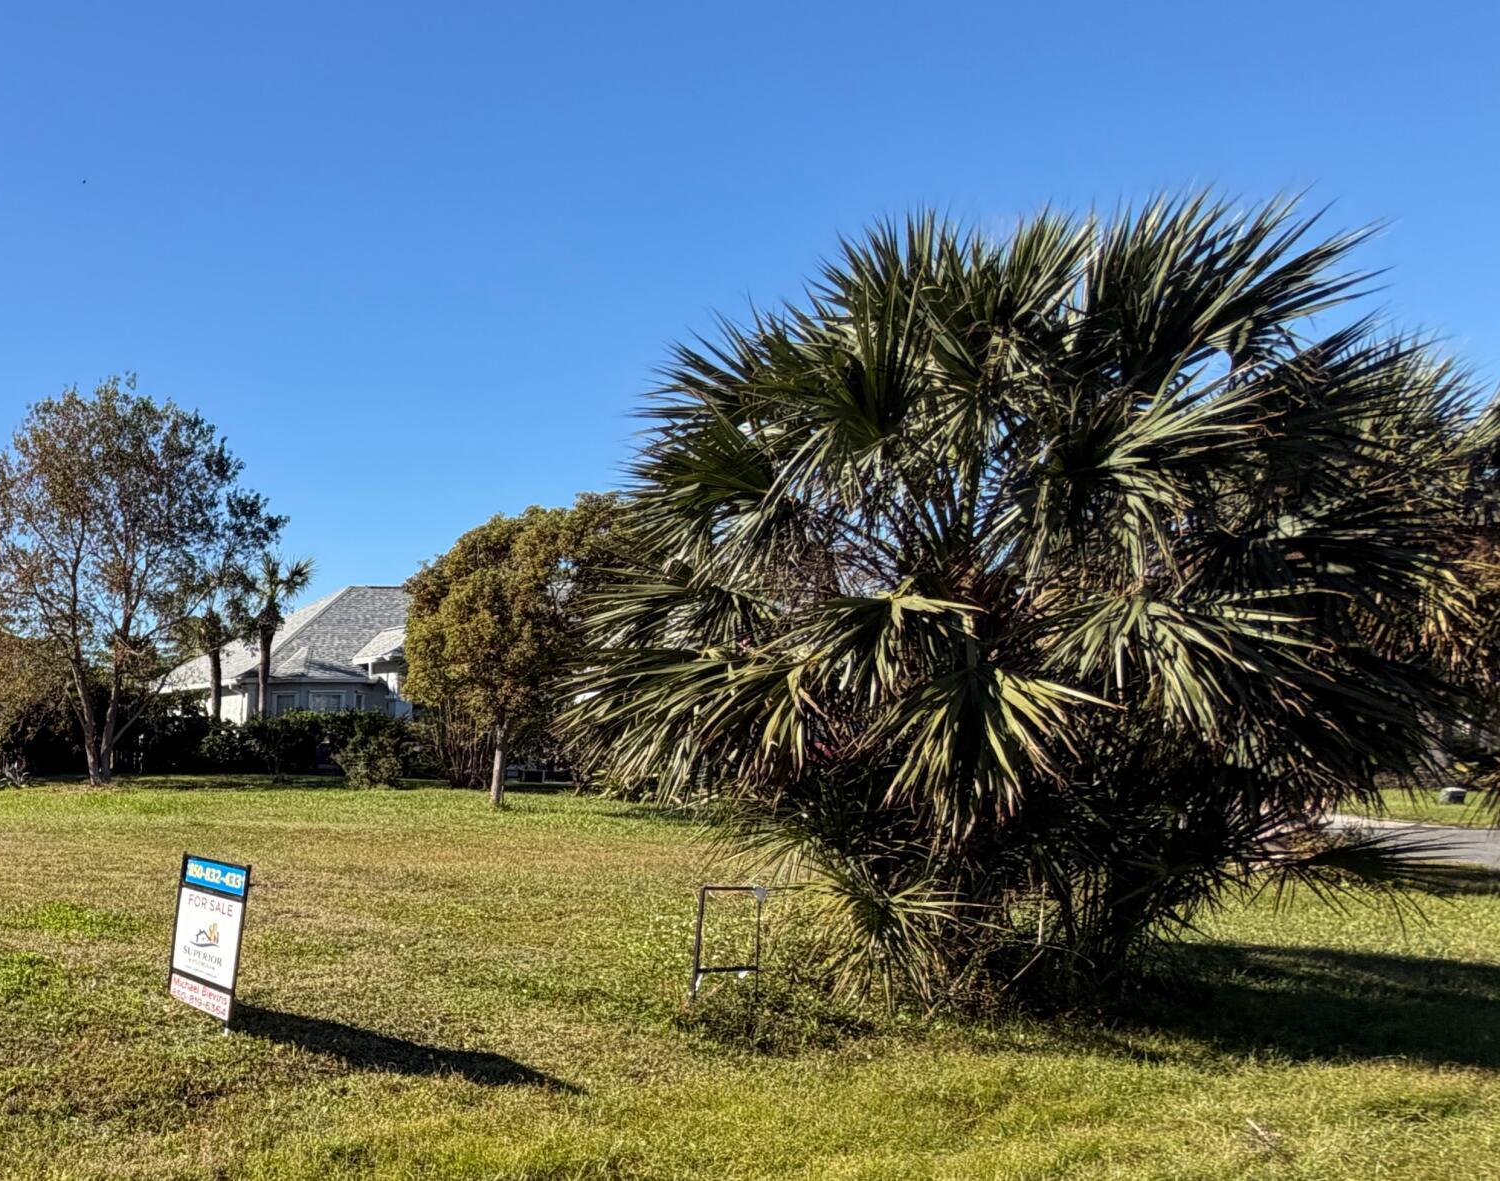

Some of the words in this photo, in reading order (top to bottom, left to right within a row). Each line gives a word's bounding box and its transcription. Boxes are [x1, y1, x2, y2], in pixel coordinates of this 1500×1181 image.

[188, 893, 208, 909] FOR
[209, 899, 233, 917] SALE
[183, 945, 222, 967] SUPERIOR
[172, 975, 199, 995] Michael
